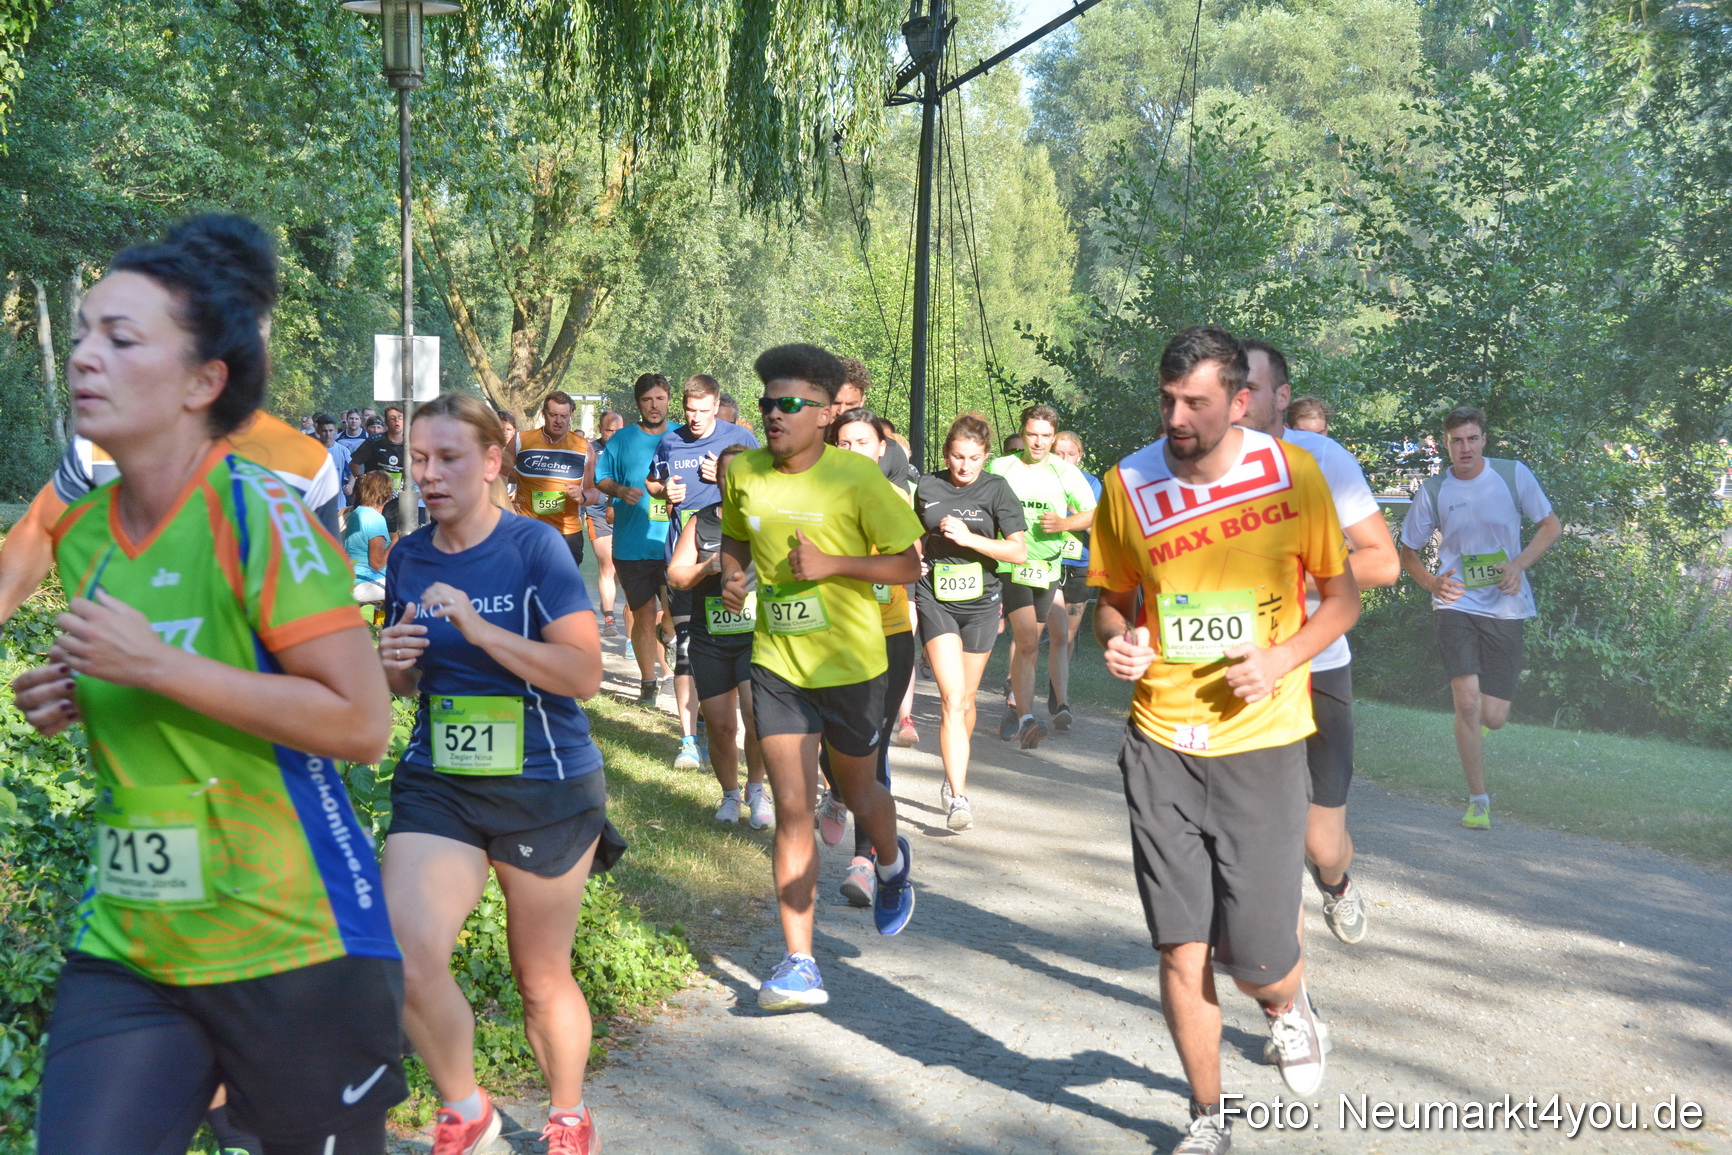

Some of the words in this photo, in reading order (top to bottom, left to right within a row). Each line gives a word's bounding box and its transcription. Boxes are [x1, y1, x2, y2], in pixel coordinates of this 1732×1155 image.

[531, 456, 572, 470] Fischer
[538, 499, 559, 509] 559
[1147, 526, 1215, 567] MAX
[1219, 500, 1299, 540] BÖGL
[1019, 567, 1043, 580] 475
[939, 576, 976, 591] 2032
[712, 607, 752, 624] 2036
[771, 601, 810, 622] 972
[1172, 615, 1244, 642] 1260
[444, 724, 494, 752] 521
[474, 753, 493, 761] Nina
[106, 827, 172, 876] 213
